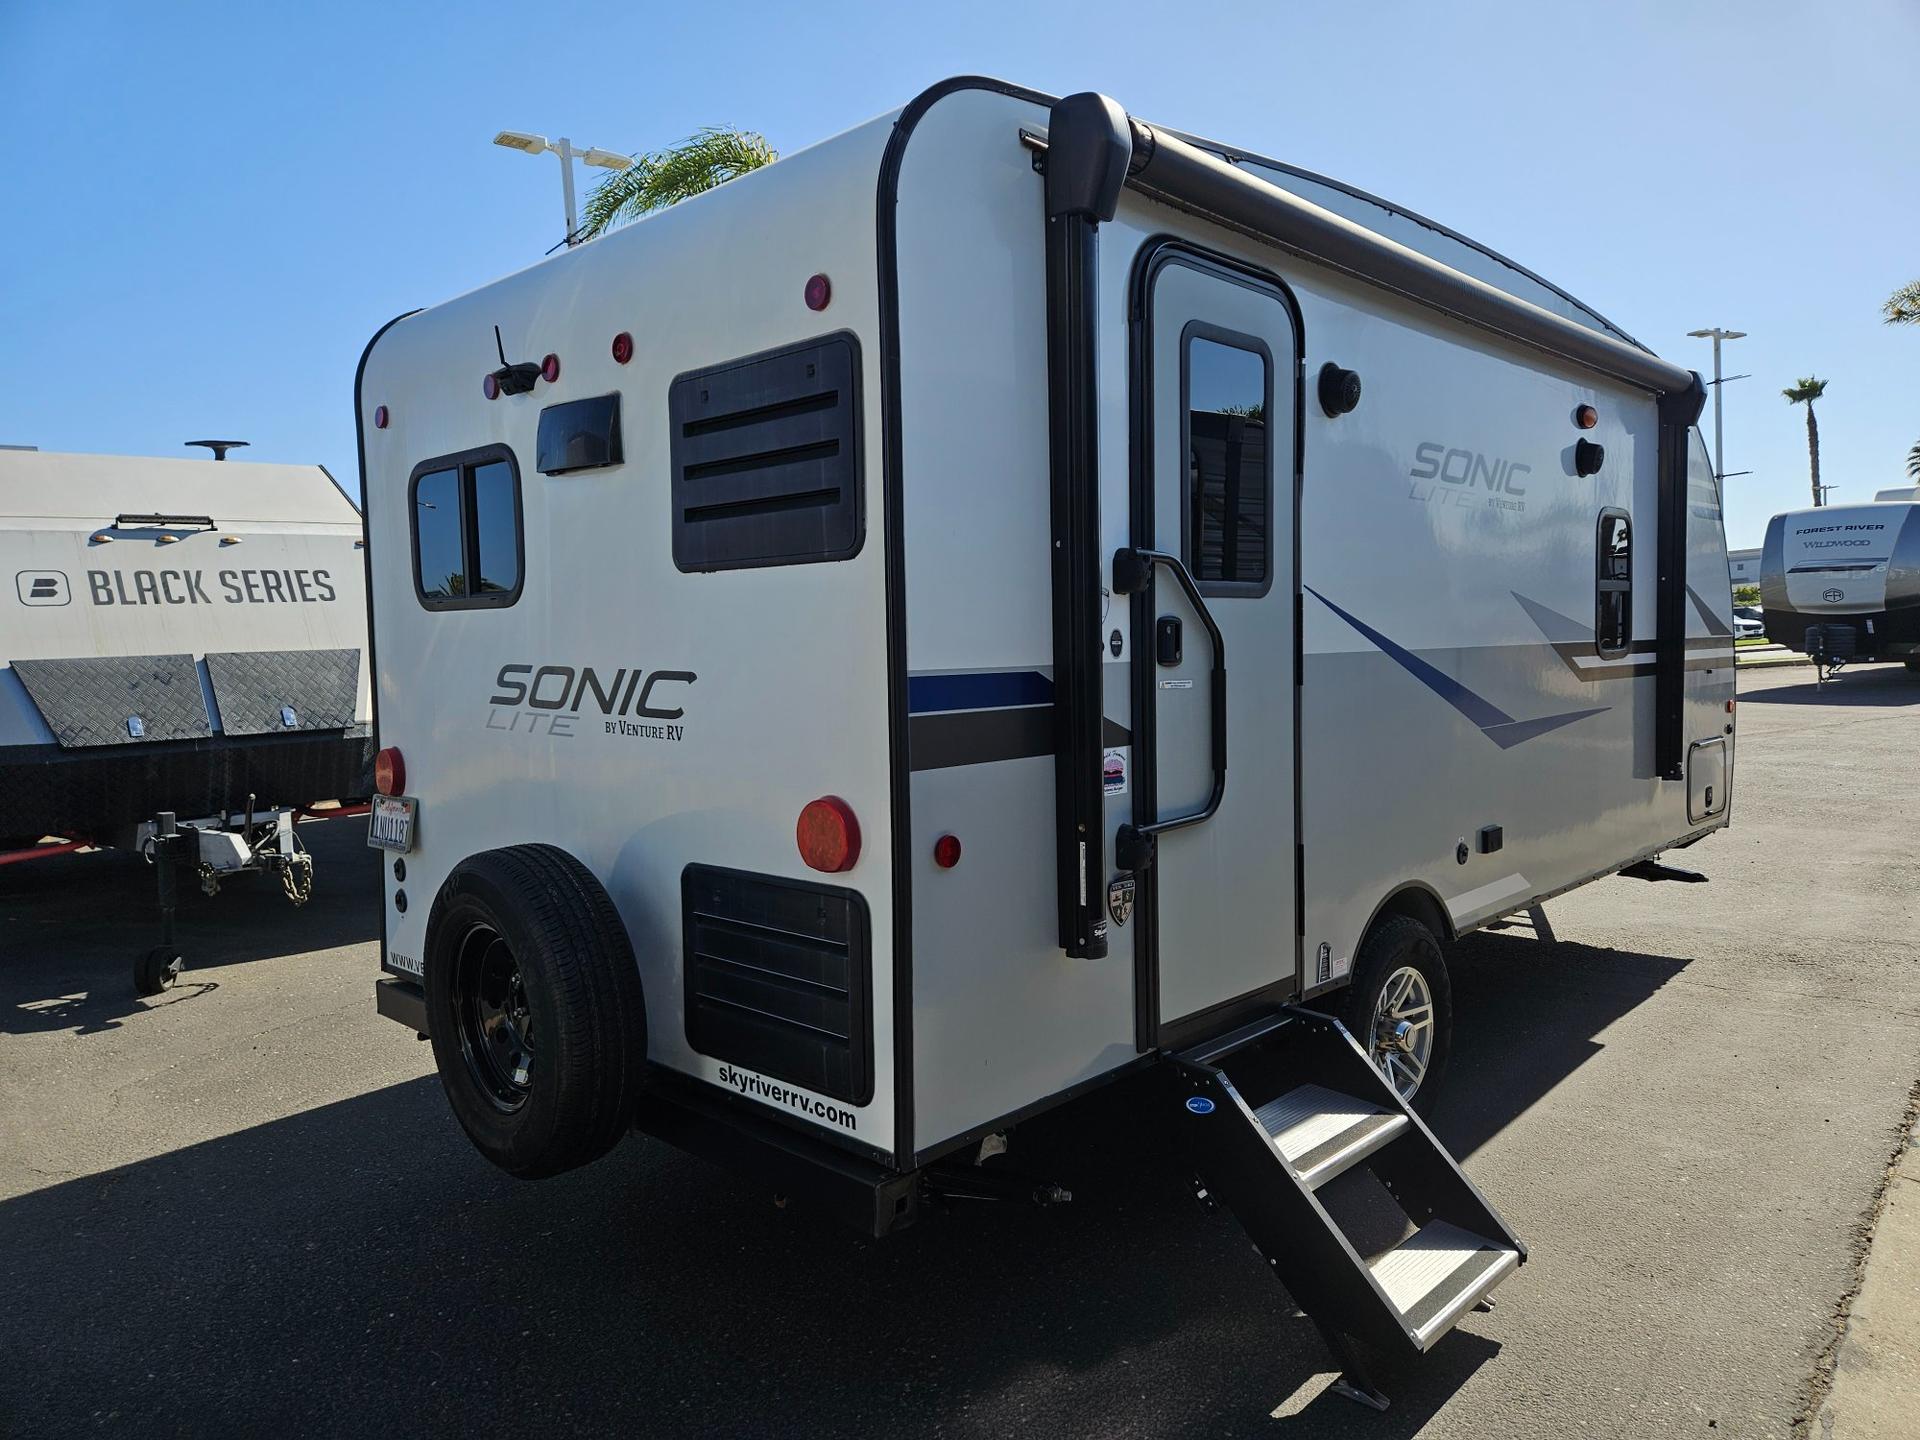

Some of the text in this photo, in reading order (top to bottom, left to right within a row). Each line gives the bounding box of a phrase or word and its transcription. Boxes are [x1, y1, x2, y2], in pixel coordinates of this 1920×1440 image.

[1410, 441, 1532, 496] SONIC
[1408, 482, 1476, 509] LITE
[1796, 526, 1842, 535] FOREST
[1803, 539, 1871, 549] WILDWOOD
[87, 568, 337, 606] BLACK SERIES
[489, 663, 698, 720] SONIC
[485, 708, 580, 738] LITE
[605, 720, 684, 741] BY VENTURE RV
[719, 1065, 857, 1131] skyriverrv.com
